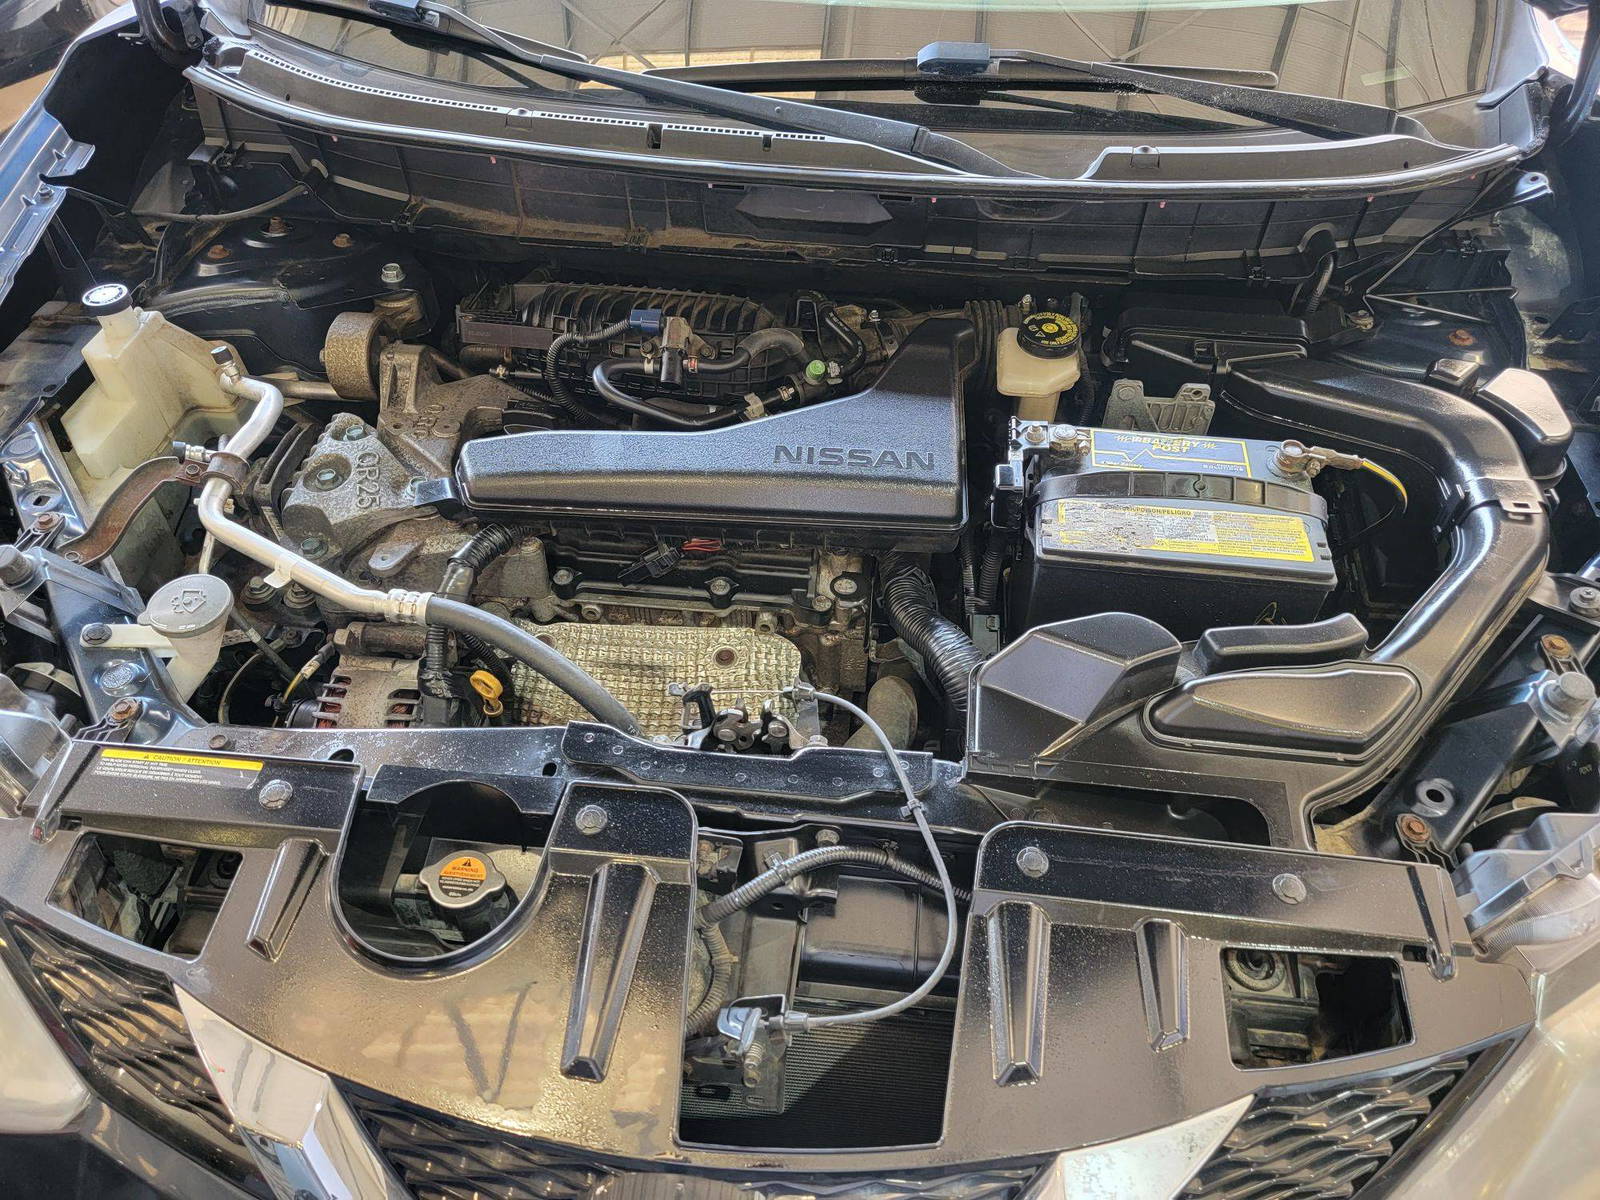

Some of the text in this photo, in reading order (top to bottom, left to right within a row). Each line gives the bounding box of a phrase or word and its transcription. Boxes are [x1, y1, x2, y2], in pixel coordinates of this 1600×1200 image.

[773, 444, 935, 471] NISSAN
[356, 451, 381, 508] QR25
[153, 755, 181, 763] CAUTION
[186, 757, 222, 766] ATTENTION
